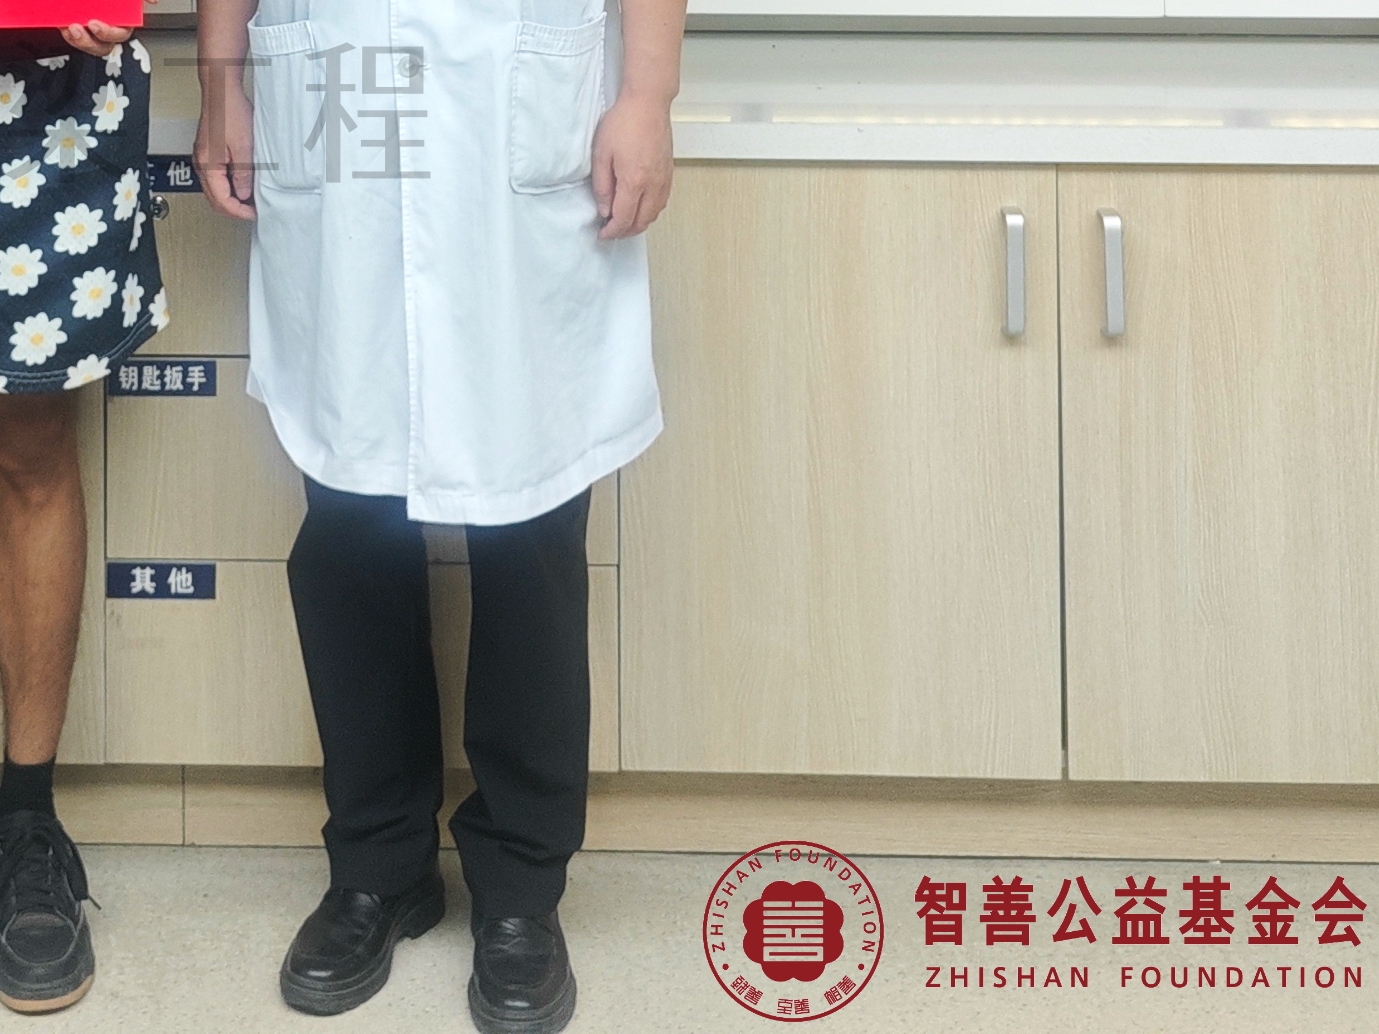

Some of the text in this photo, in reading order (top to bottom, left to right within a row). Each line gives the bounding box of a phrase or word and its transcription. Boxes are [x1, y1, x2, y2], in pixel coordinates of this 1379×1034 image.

[118, 364, 207, 392] 钥匙扳手
[129, 566, 195, 594] 其他
